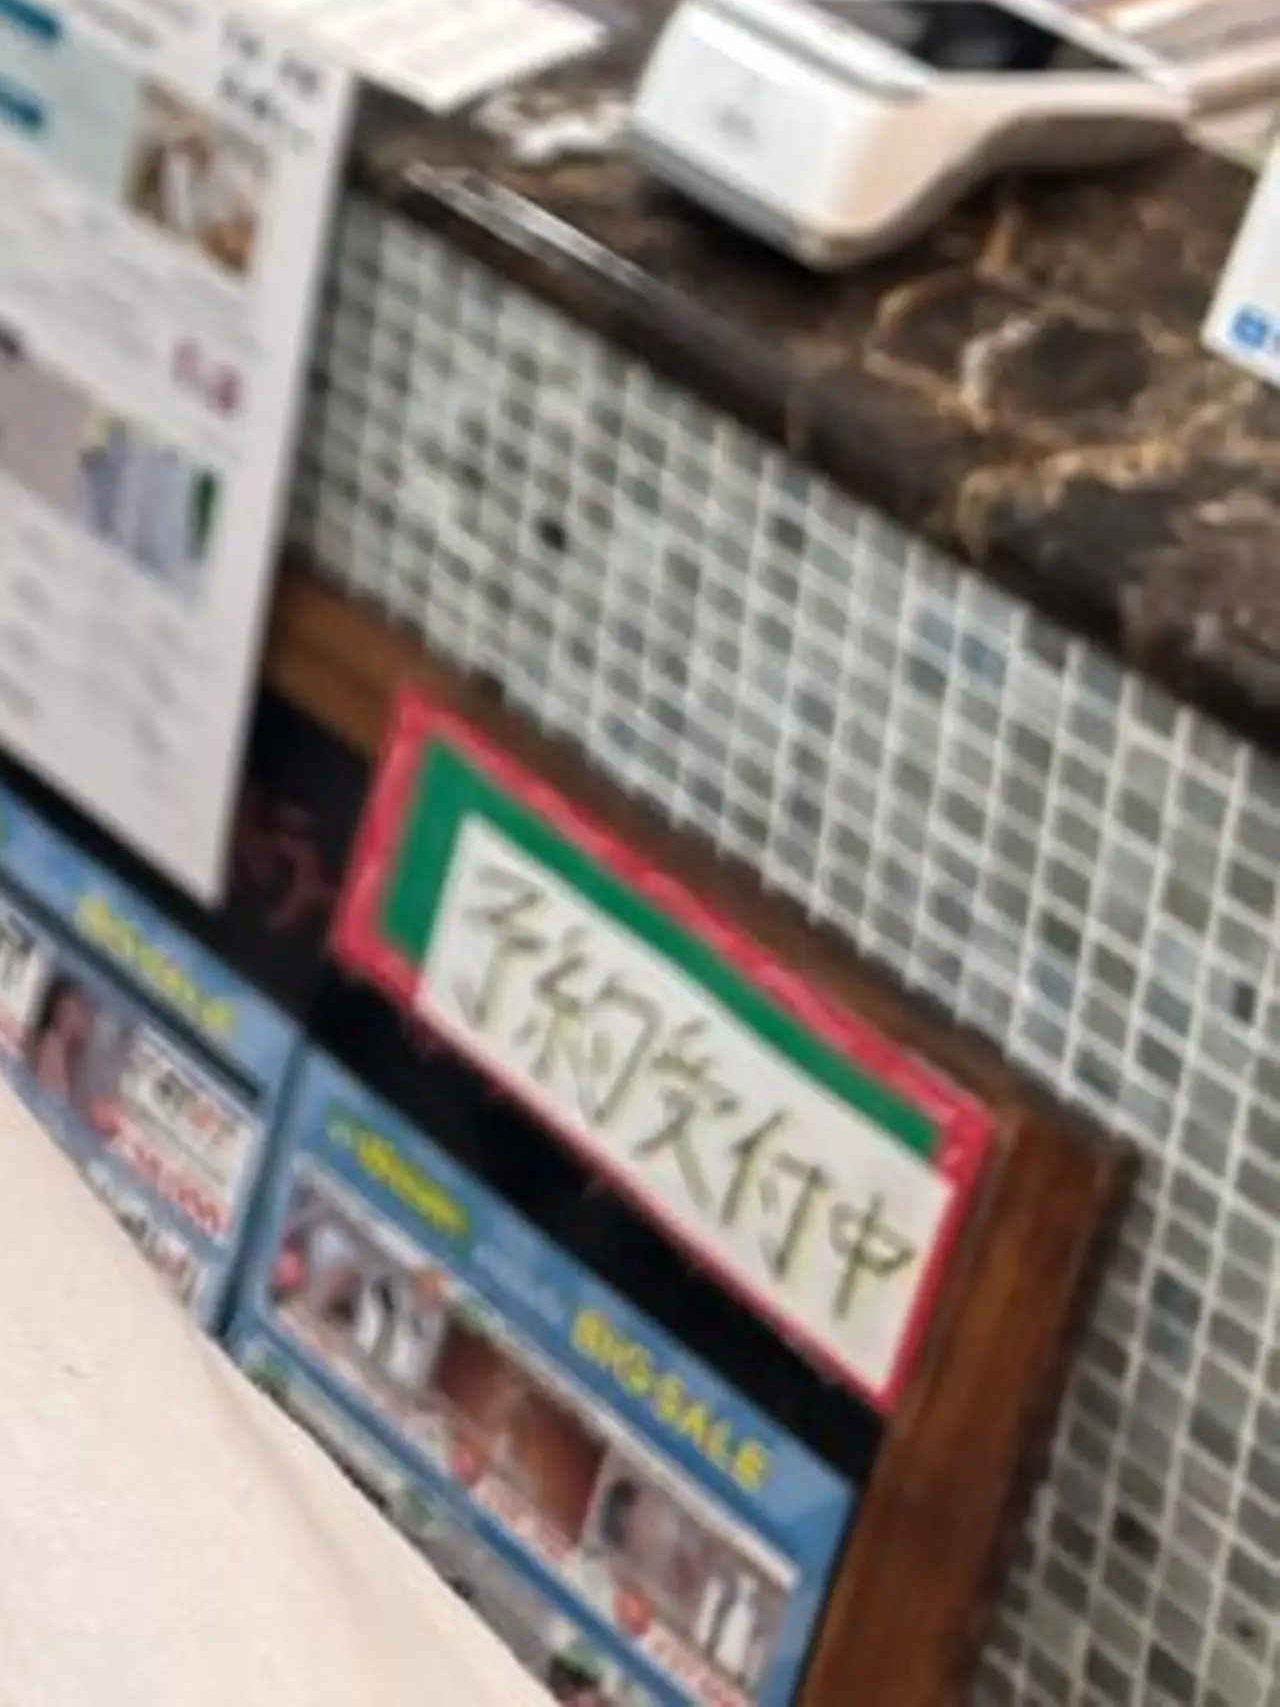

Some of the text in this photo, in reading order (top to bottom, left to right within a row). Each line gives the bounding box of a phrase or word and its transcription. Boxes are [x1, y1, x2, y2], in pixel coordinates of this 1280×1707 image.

[462, 863, 920, 1322] 予約受付中
